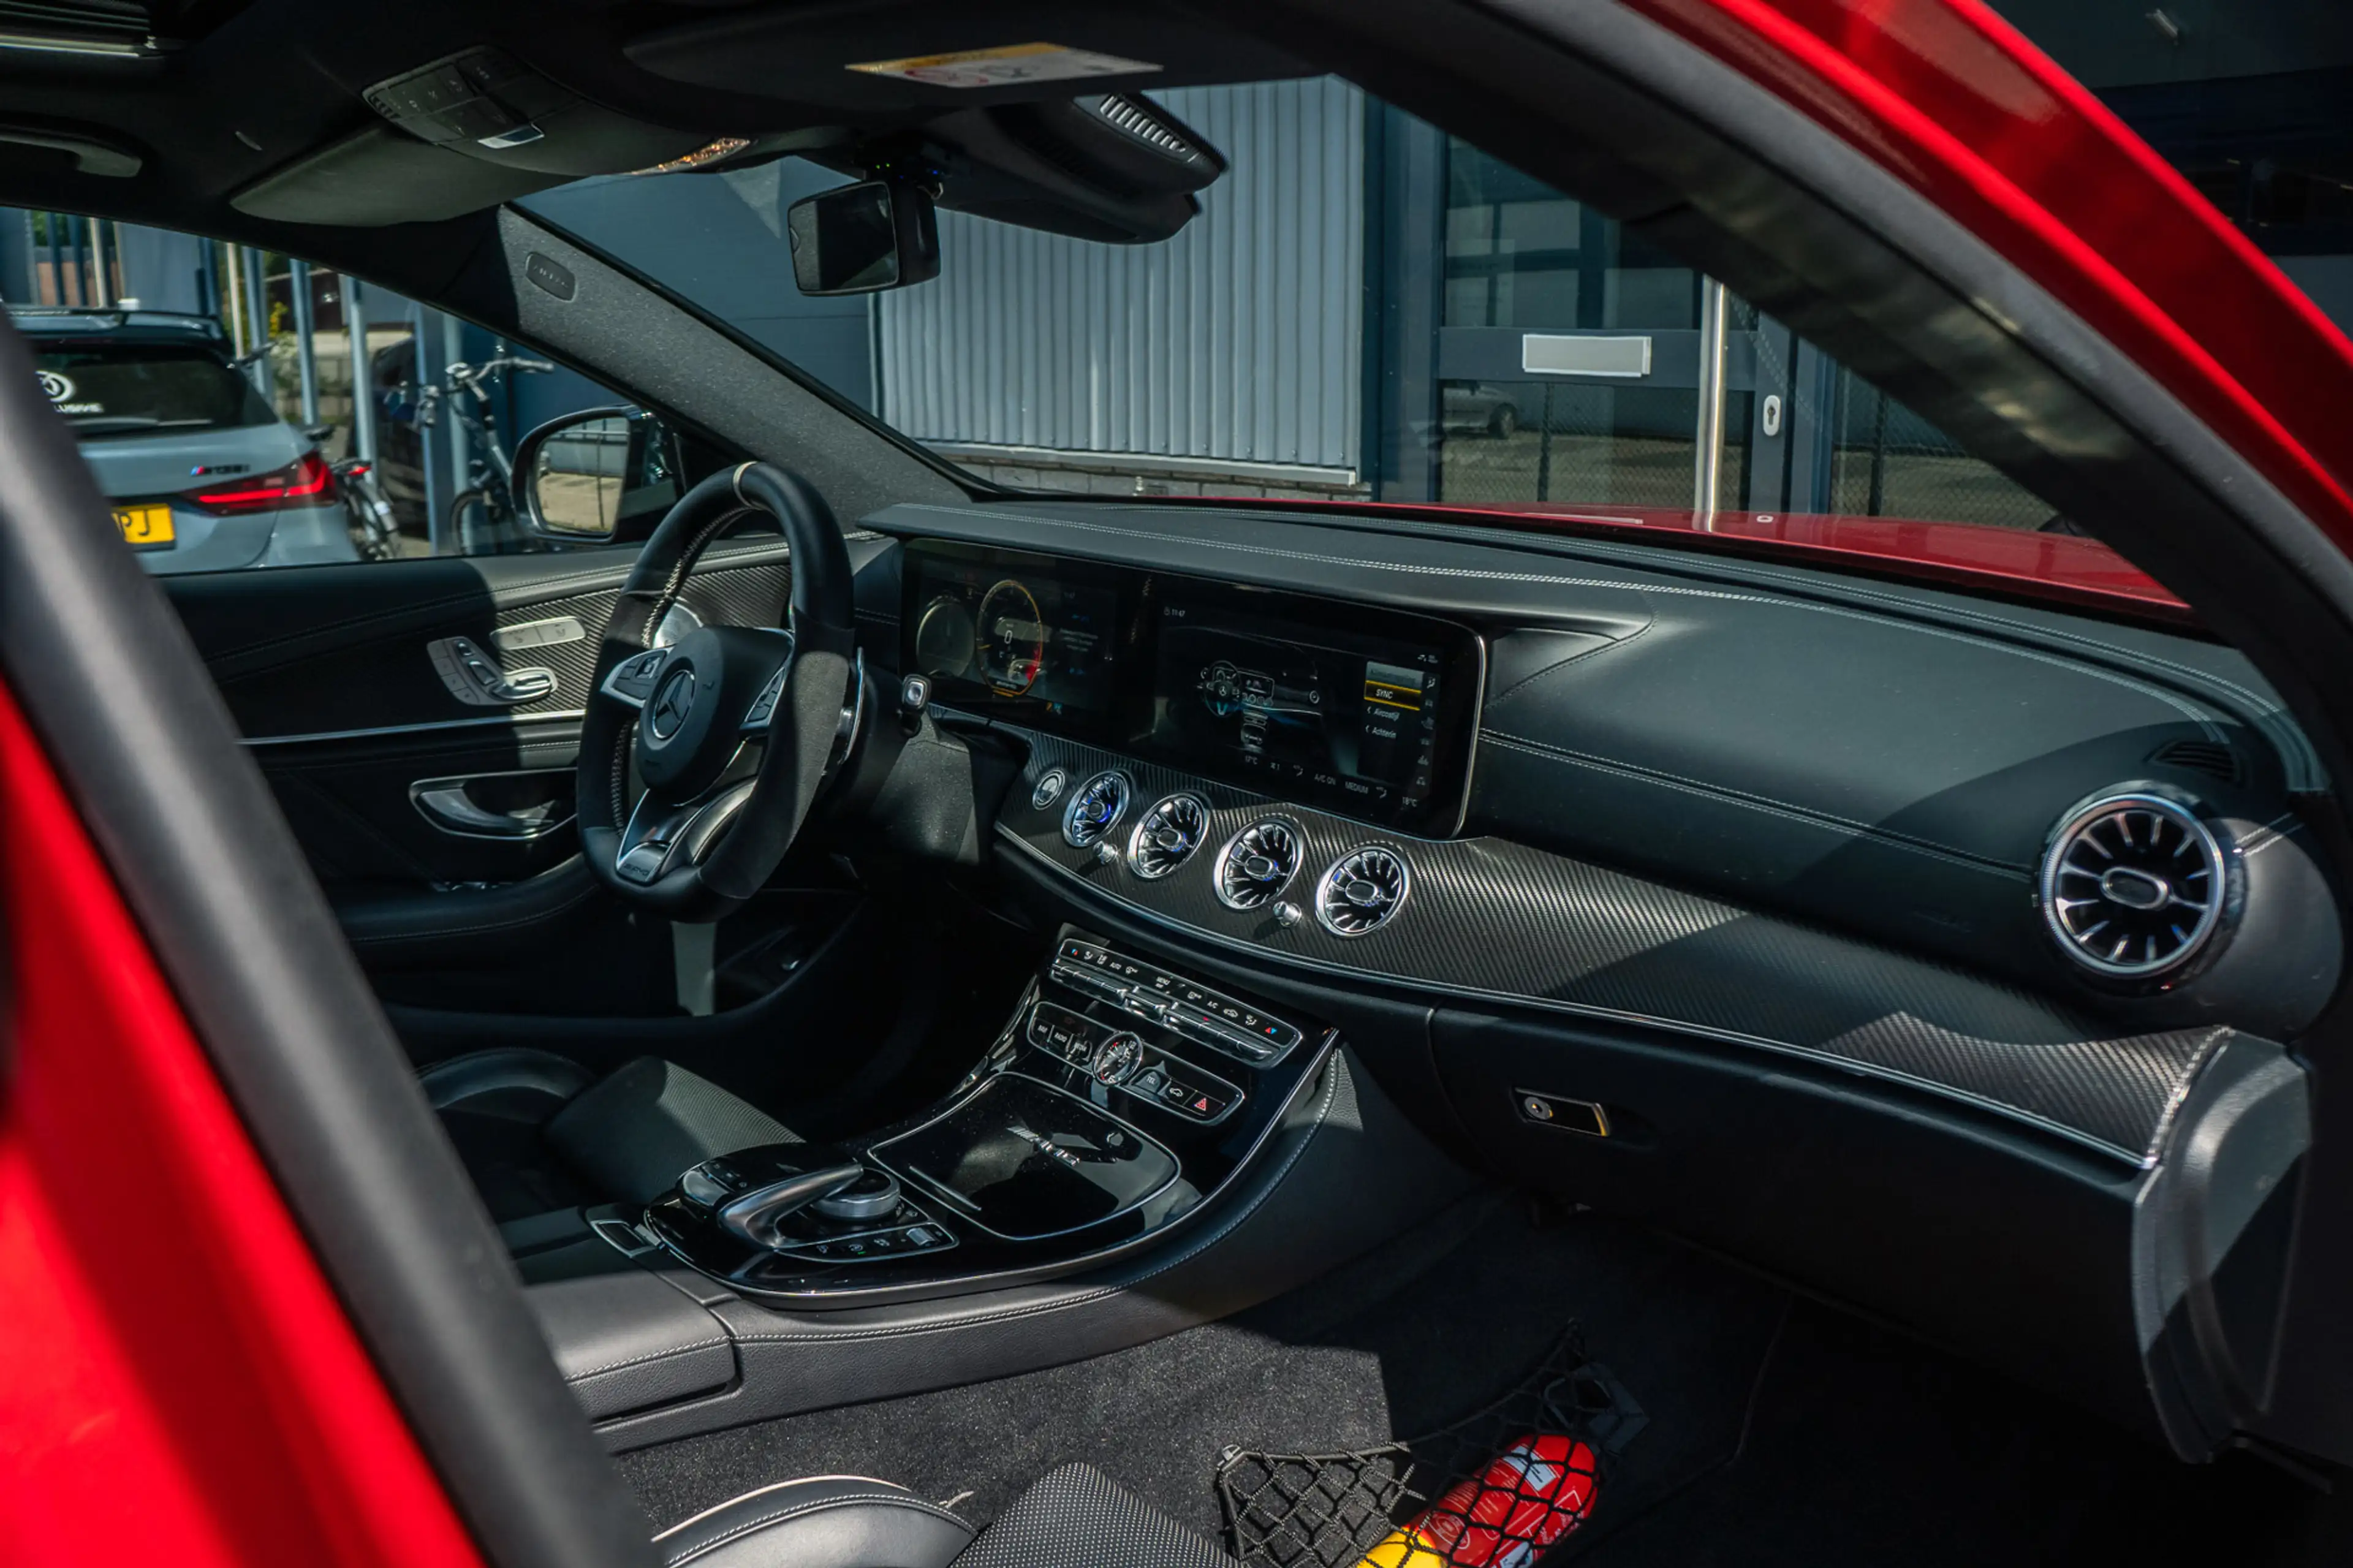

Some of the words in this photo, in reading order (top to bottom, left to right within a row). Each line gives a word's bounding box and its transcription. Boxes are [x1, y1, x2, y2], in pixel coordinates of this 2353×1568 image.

[1375, 688, 1394, 700] SYNC
[1344, 781, 1369, 795] MEDIUM
[1110, 962, 1122, 971] AUTO
[1053, 1032, 1068, 1043] RADIO
[1146, 1075, 1156, 1085] TEL
